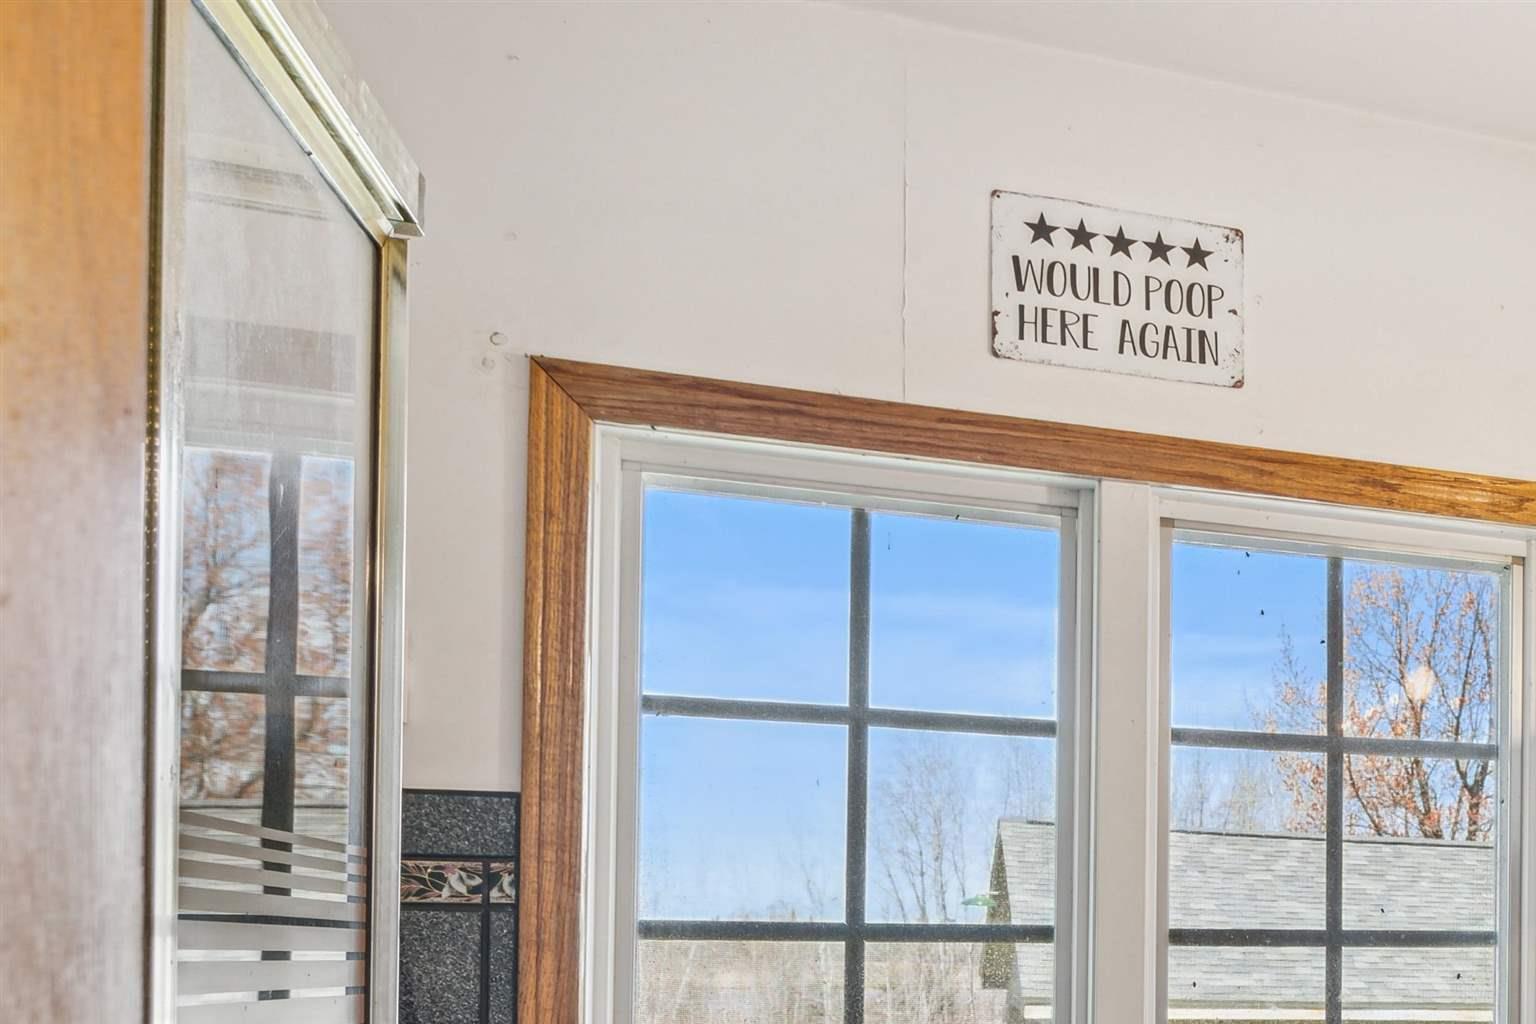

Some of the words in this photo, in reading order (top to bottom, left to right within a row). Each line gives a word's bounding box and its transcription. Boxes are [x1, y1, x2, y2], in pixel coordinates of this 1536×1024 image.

[1012, 255, 1131, 307] WOULD
[1145, 275, 1224, 319] POOP
[1018, 304, 1098, 351] HERE
[1118, 319, 1218, 366] AGAIN
